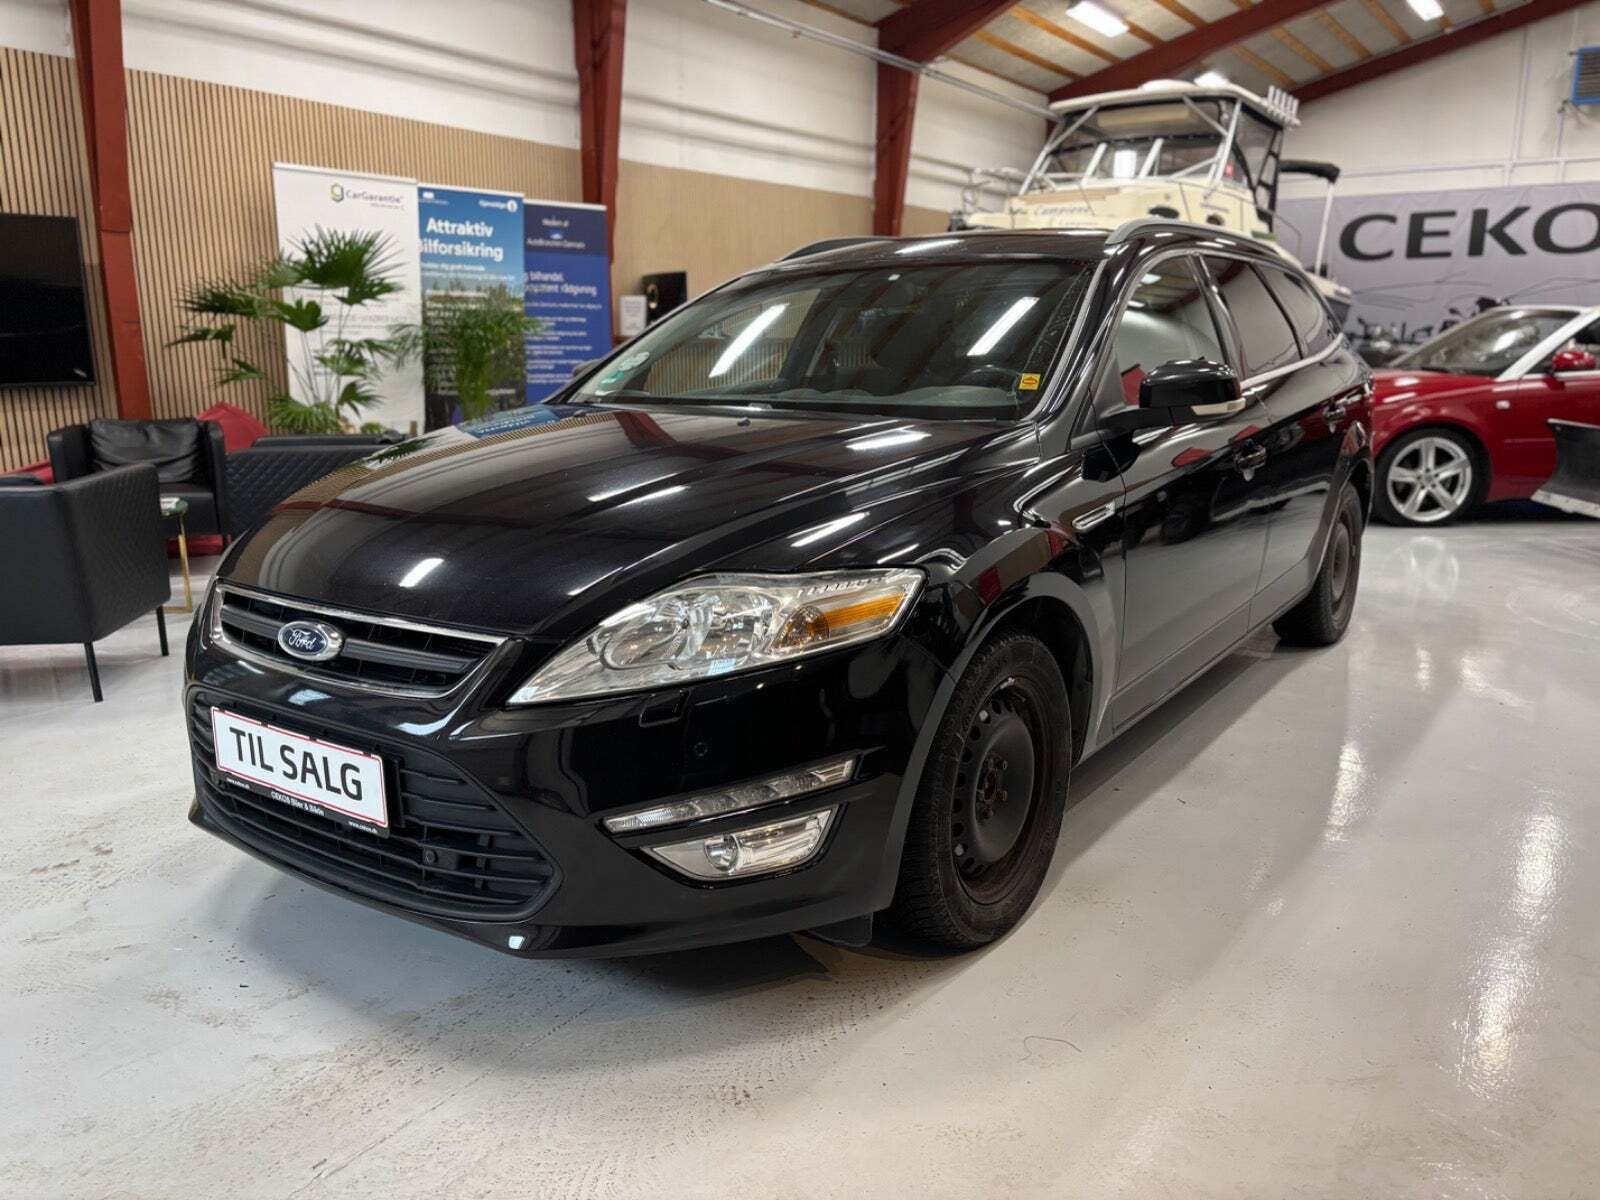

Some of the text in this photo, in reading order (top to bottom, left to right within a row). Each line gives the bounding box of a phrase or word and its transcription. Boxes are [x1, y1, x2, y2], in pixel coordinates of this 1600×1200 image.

[426, 217, 494, 237] Attraktiv
[1339, 203, 1600, 261] CEKO
[288, 628, 318, 651] Ford
[229, 726, 363, 801] TIL SALG
